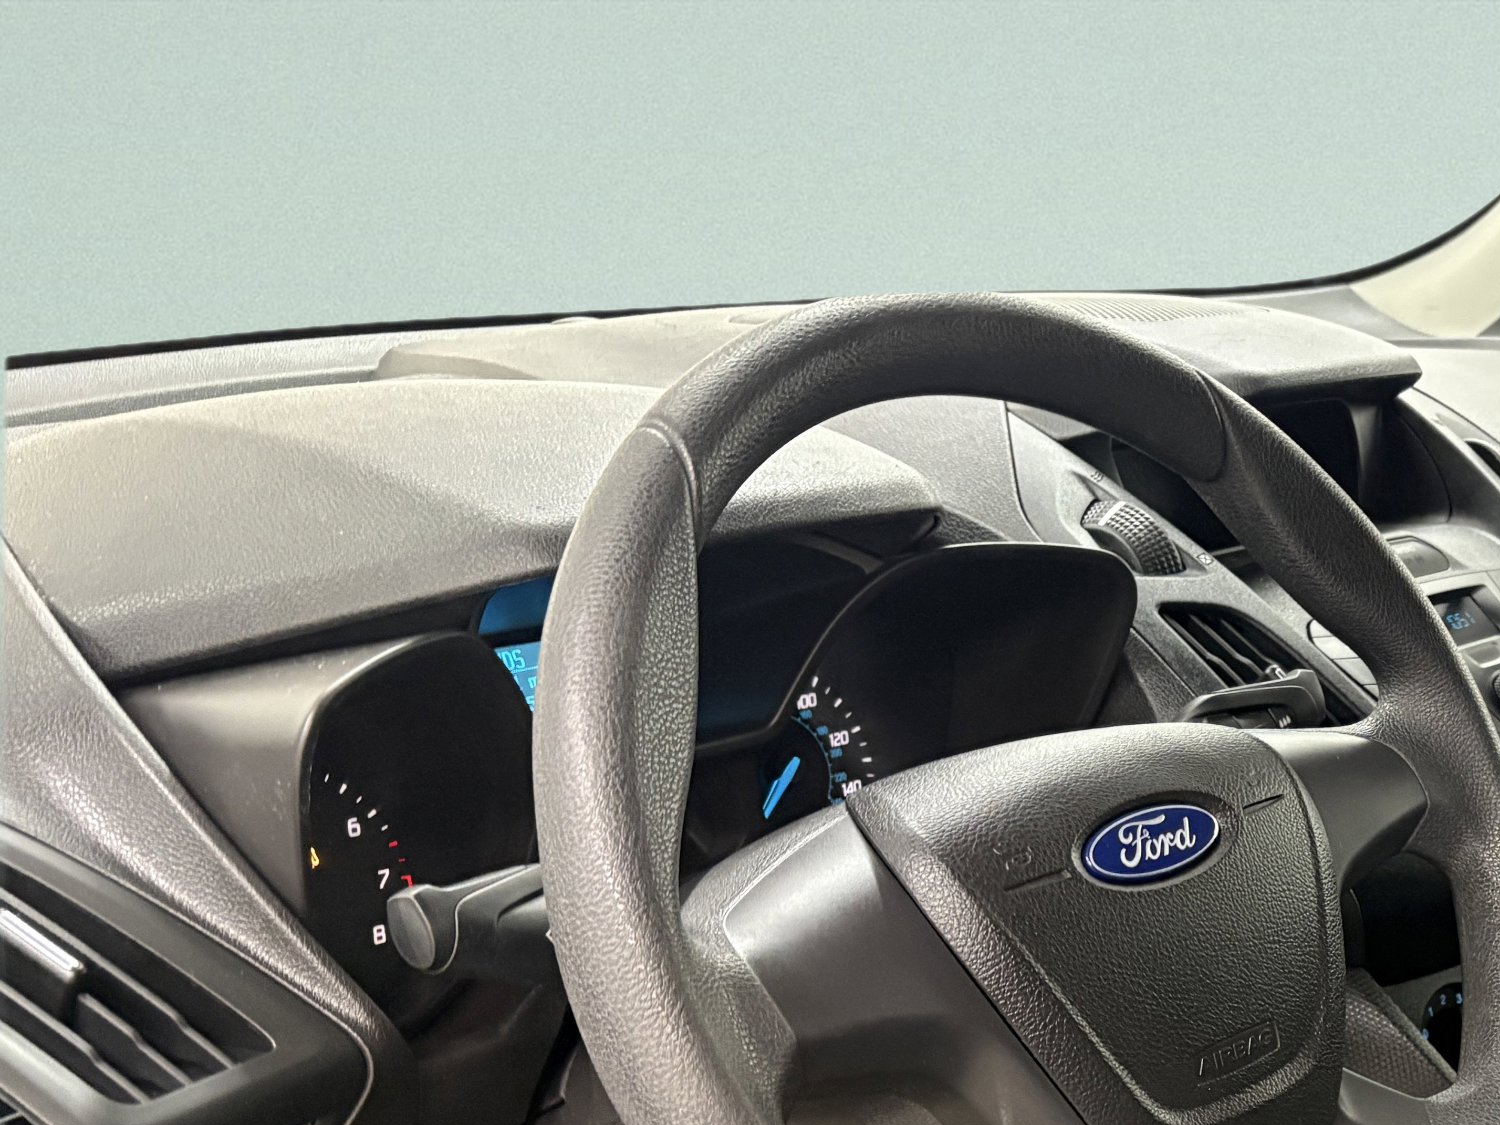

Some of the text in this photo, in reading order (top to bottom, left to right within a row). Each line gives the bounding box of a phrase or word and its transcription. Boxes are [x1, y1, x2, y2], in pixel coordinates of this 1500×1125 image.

[829, 730, 850, 747] 120
[842, 780, 862, 797] 140
[347, 817, 361, 838] 6
[1118, 813, 1196, 868] Ford
[377, 868, 390, 890] 7
[372, 924, 387, 946] 8
[1428, 1006, 1434, 1017] 1
[1440, 994, 1447, 1005] 2
[1455, 992, 1463, 1004] 3
[1199, 1027, 1273, 1077] AIRBAG
